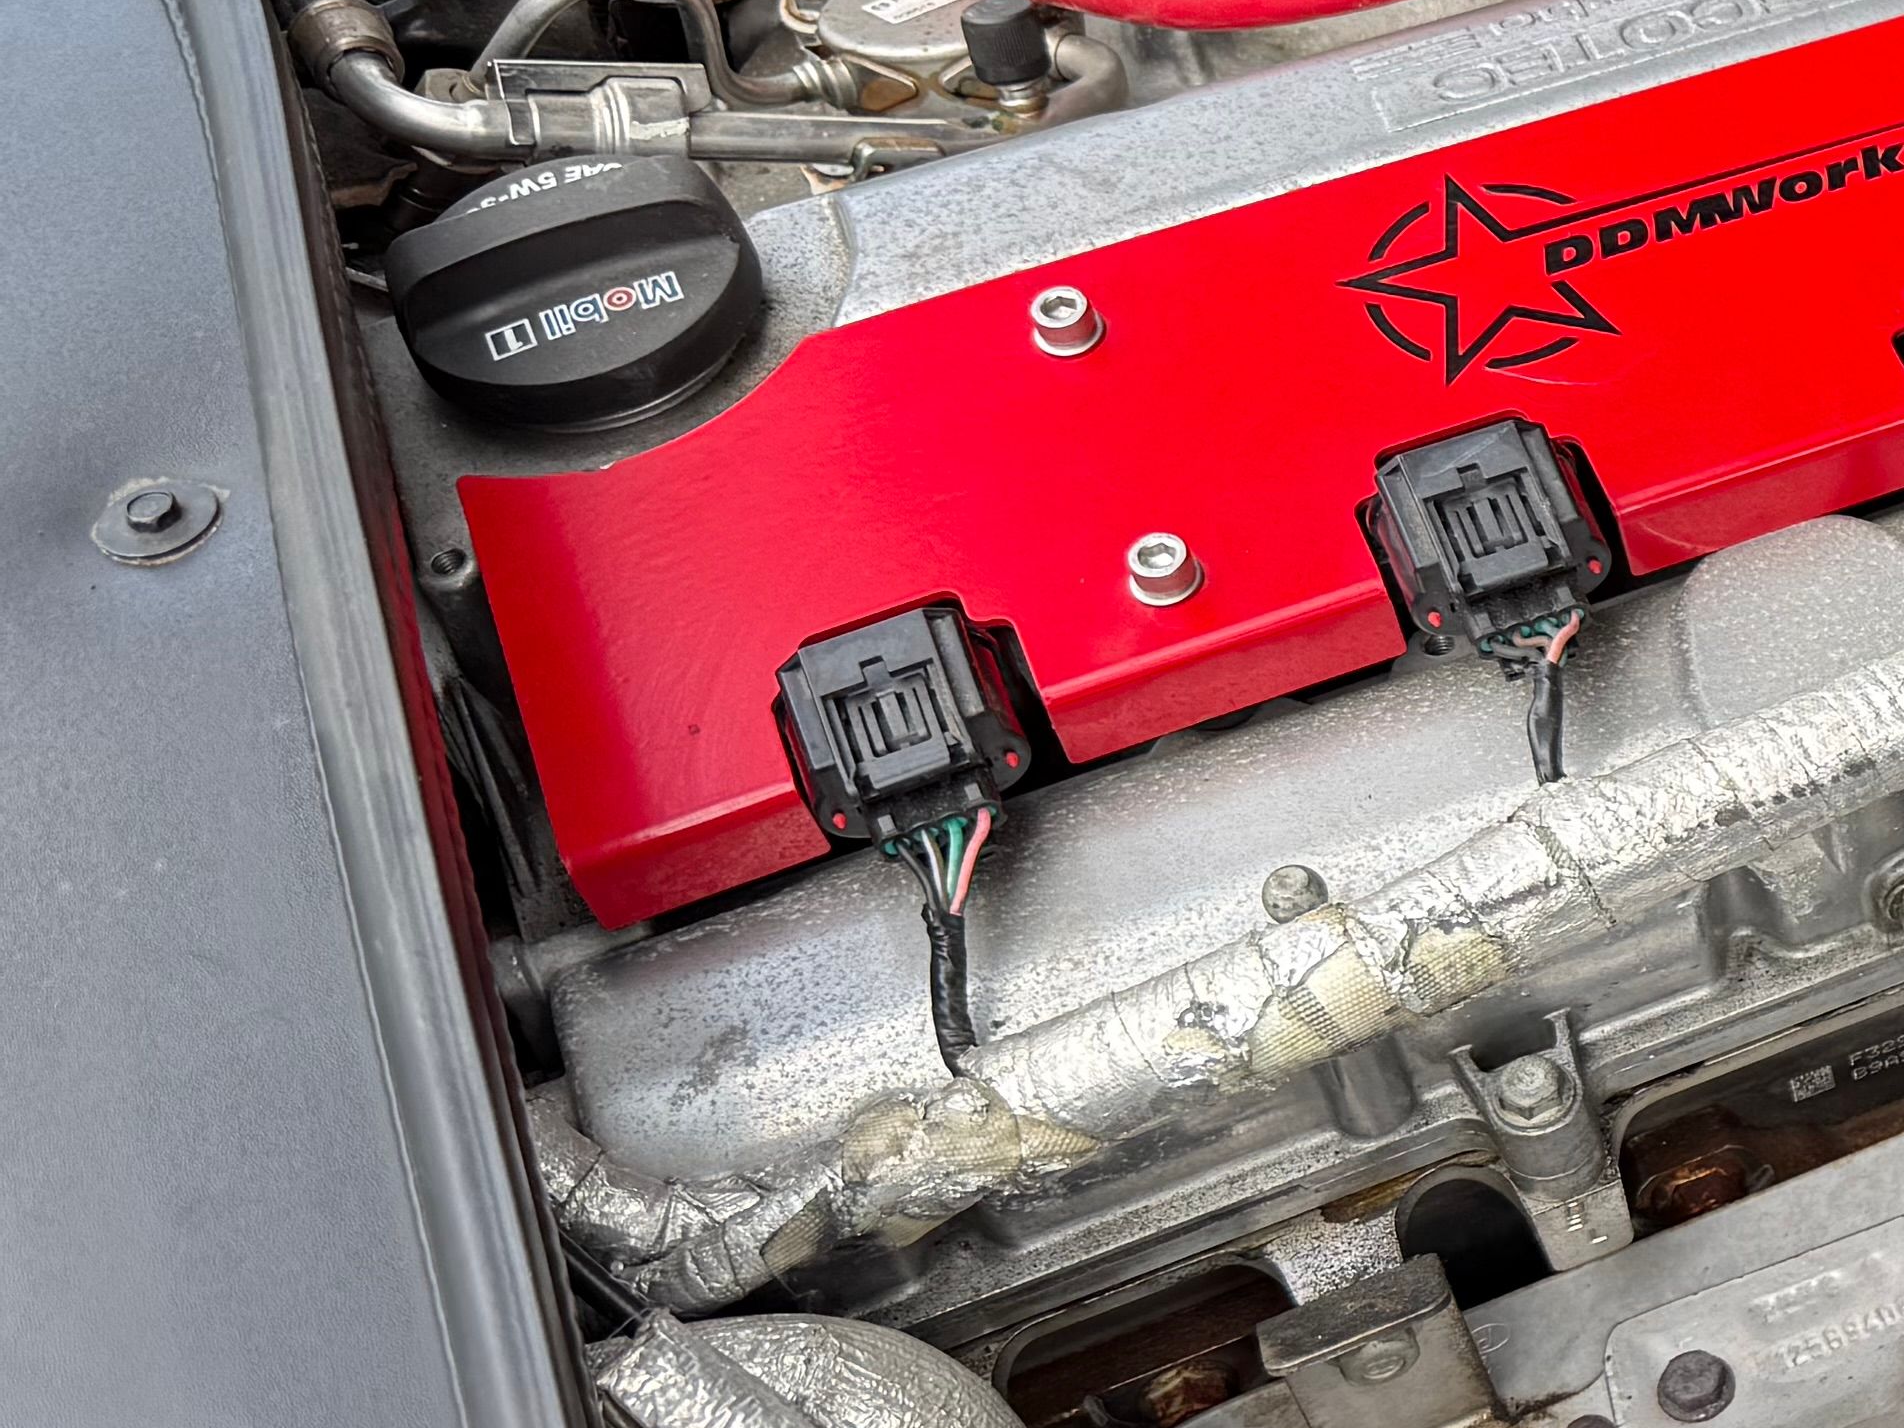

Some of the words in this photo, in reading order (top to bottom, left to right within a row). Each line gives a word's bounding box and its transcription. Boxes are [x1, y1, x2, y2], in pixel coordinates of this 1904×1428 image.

[466, 171, 558, 213] 5W-3
[547, 270, 684, 342] Mobil
[490, 321, 536, 360] 1
